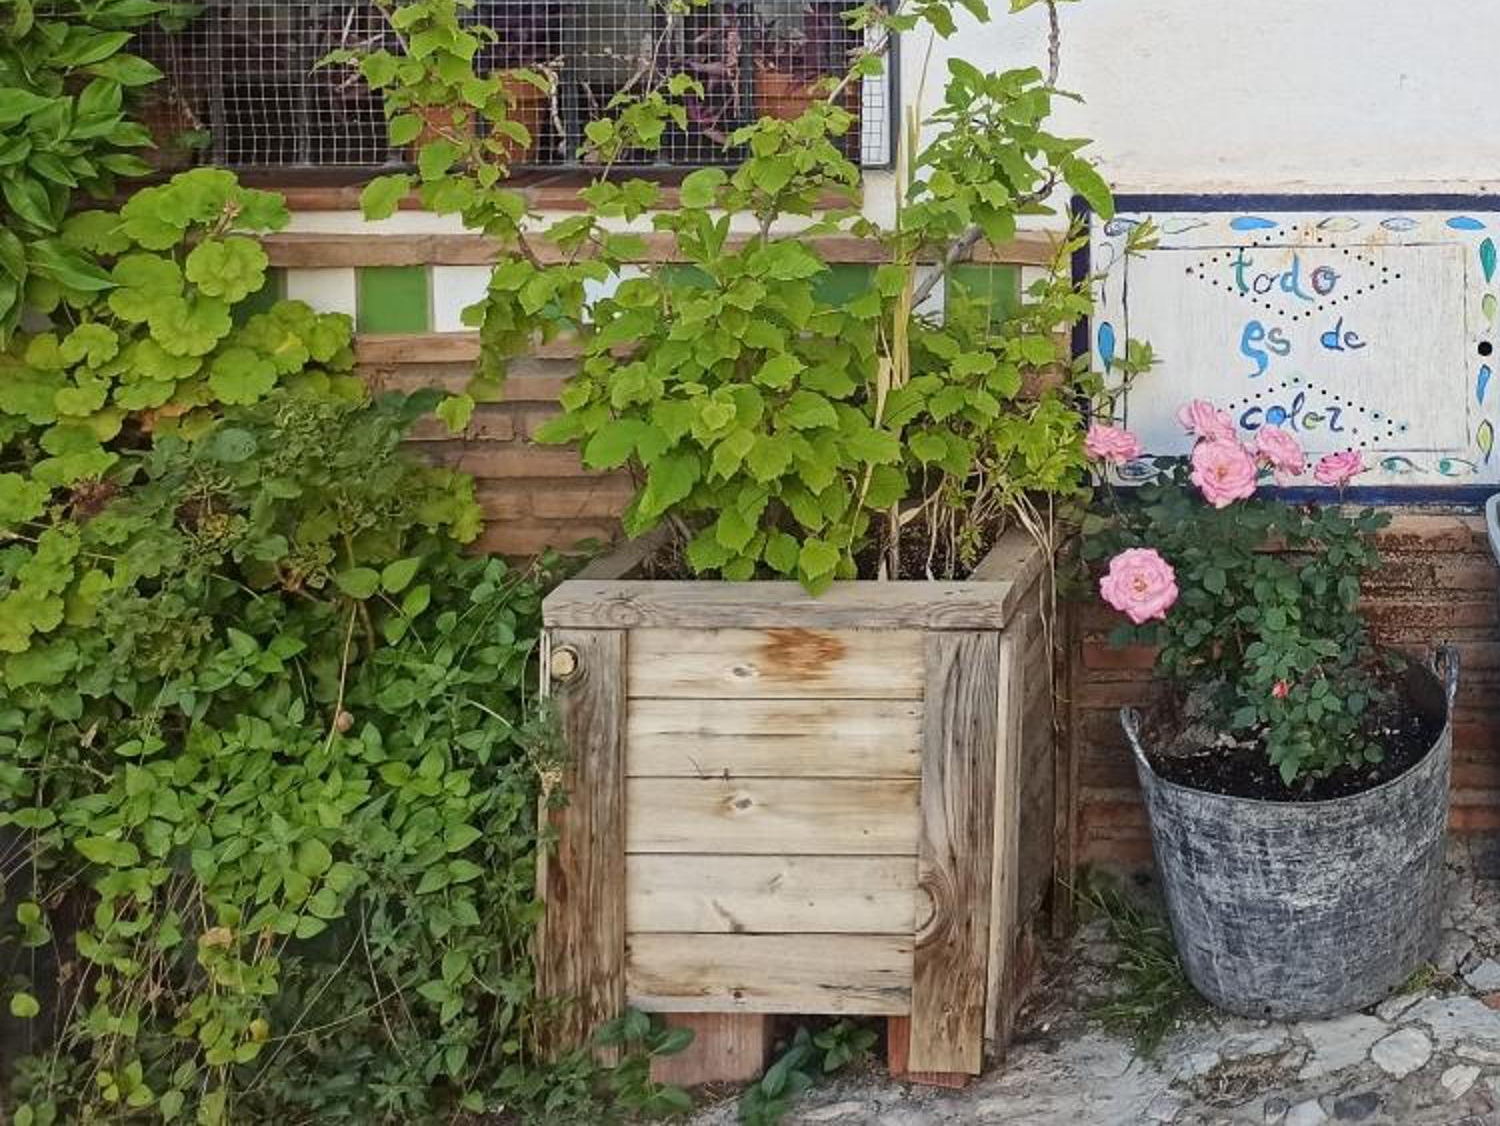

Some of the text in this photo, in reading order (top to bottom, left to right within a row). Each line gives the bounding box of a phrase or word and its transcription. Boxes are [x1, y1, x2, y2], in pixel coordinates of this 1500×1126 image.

[1229, 248, 1341, 301] todo
[1241, 316, 1366, 378] es de
